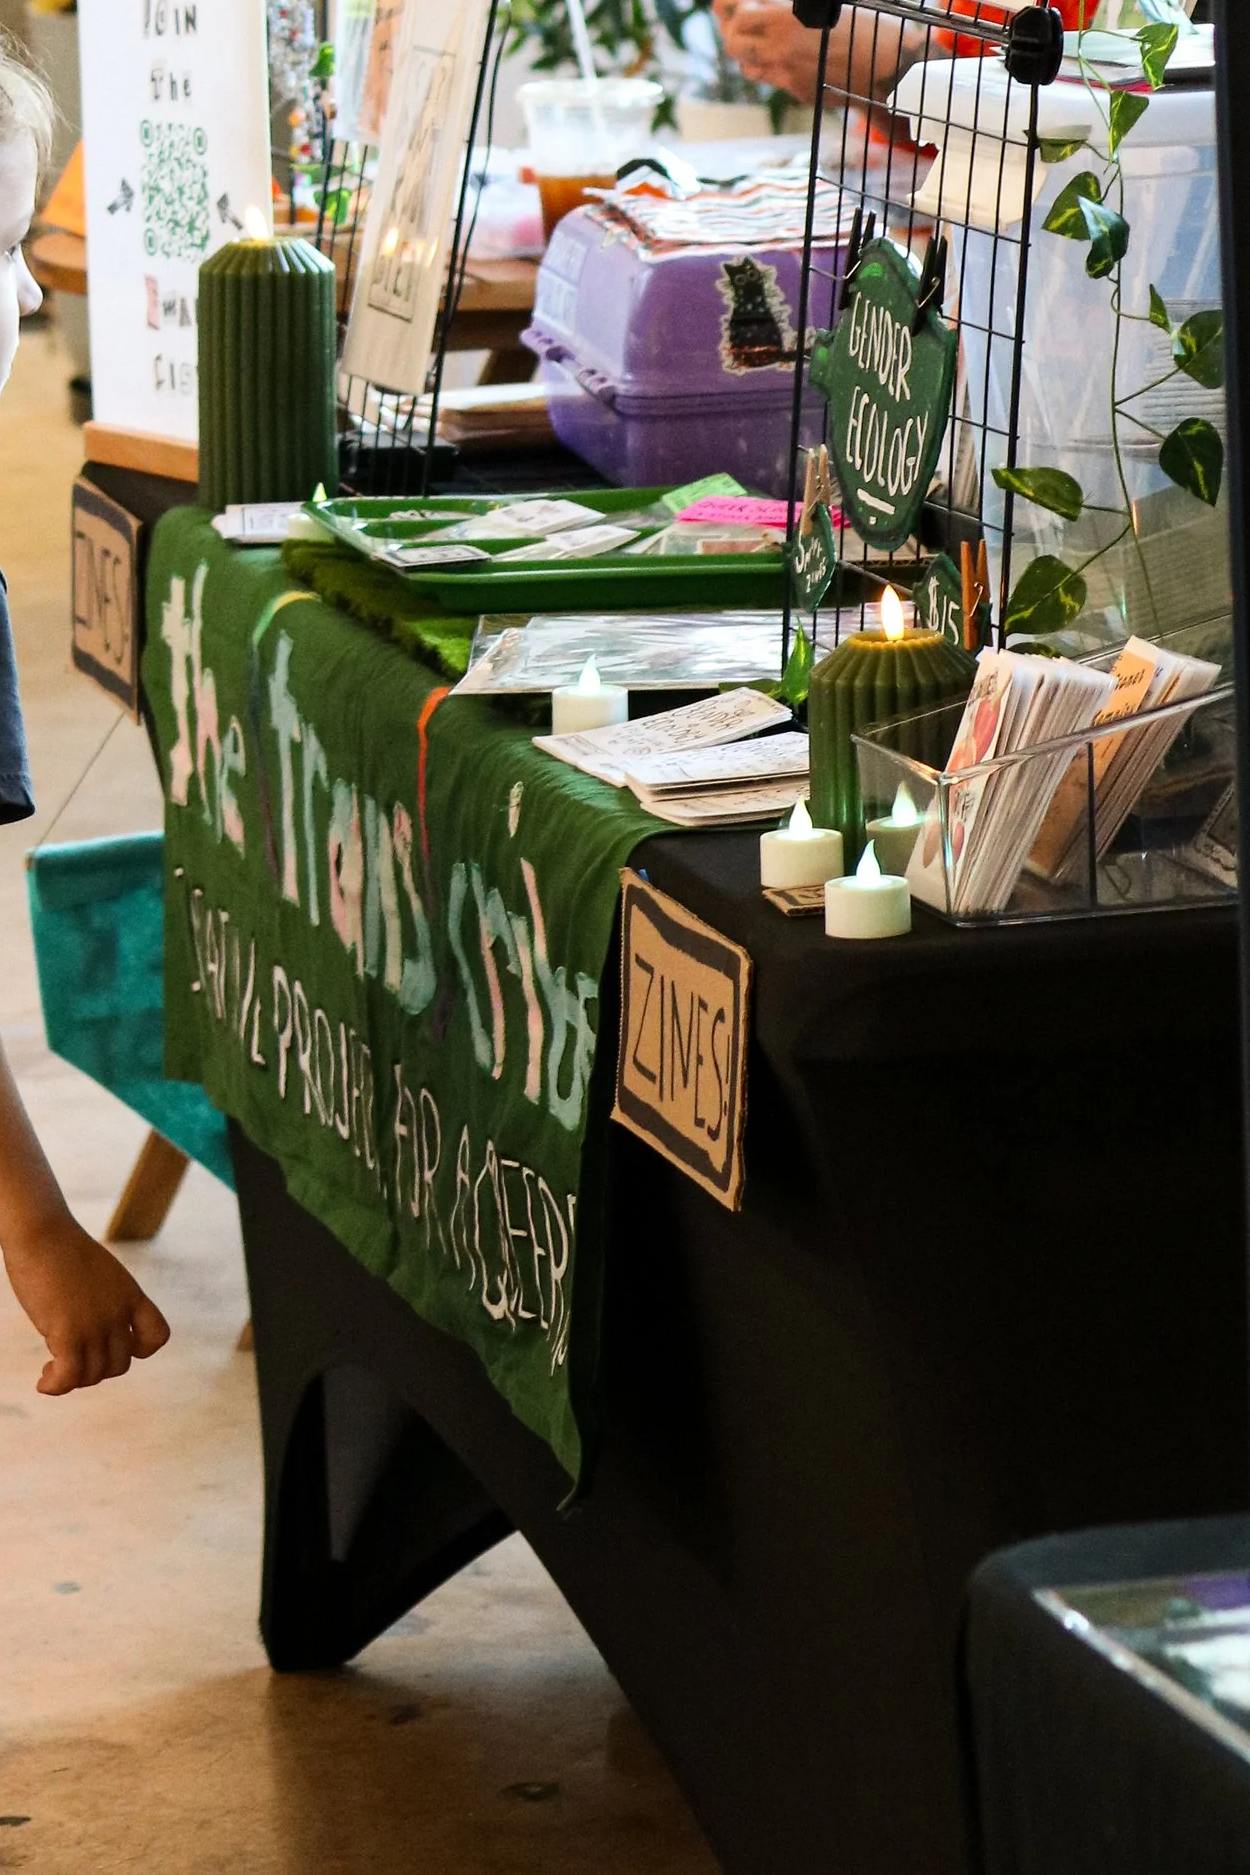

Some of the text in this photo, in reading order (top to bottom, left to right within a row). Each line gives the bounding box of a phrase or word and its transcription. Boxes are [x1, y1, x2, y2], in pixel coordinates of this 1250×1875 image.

[849, 290, 913, 403] GENDER
[845, 385, 930, 498] ECOLOGY
[926, 573, 961, 646] $15
[633, 952, 732, 1142] ZINES!
